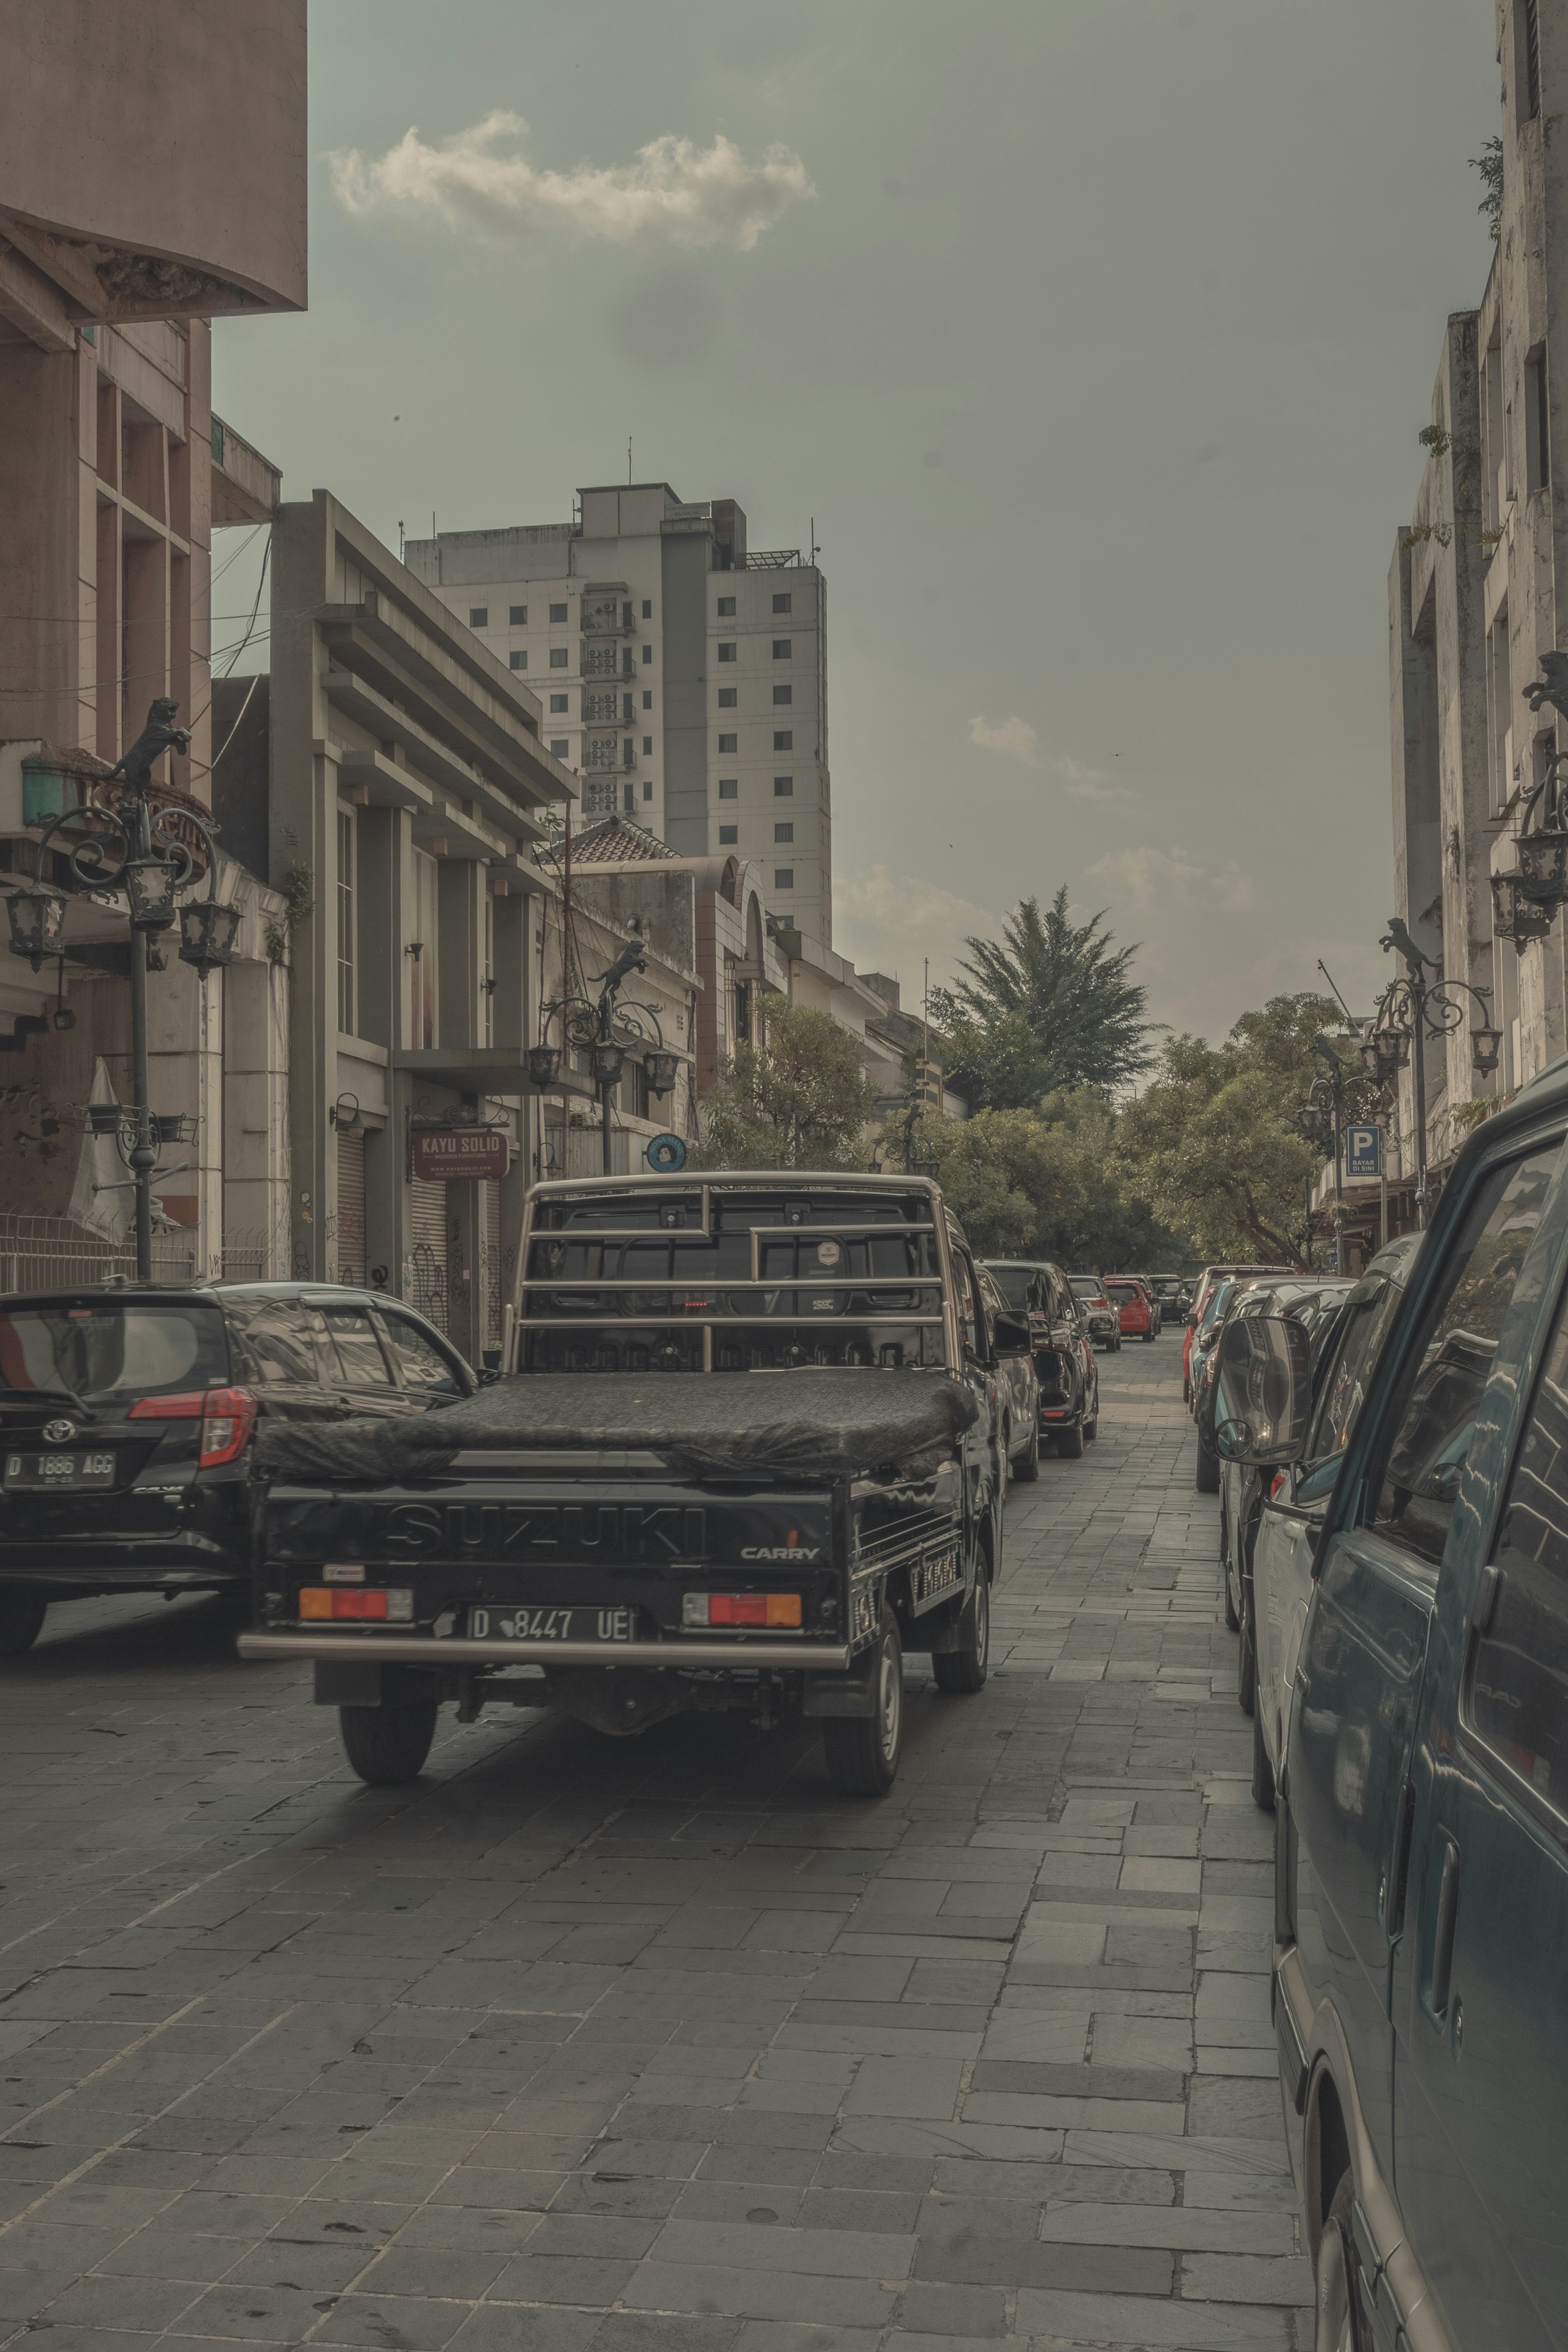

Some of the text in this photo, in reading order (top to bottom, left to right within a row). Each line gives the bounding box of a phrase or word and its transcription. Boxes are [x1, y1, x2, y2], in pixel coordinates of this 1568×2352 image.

[422, 1136, 500, 1153] KAYU SOLID
[1354, 1132, 1373, 1157] P
[8, 1457, 21, 1476] D
[386, 1504, 704, 1555] SUZUKI
[740, 1547, 821, 1559] CARRY
[474, 1609, 628, 1640] D 8447 UE
